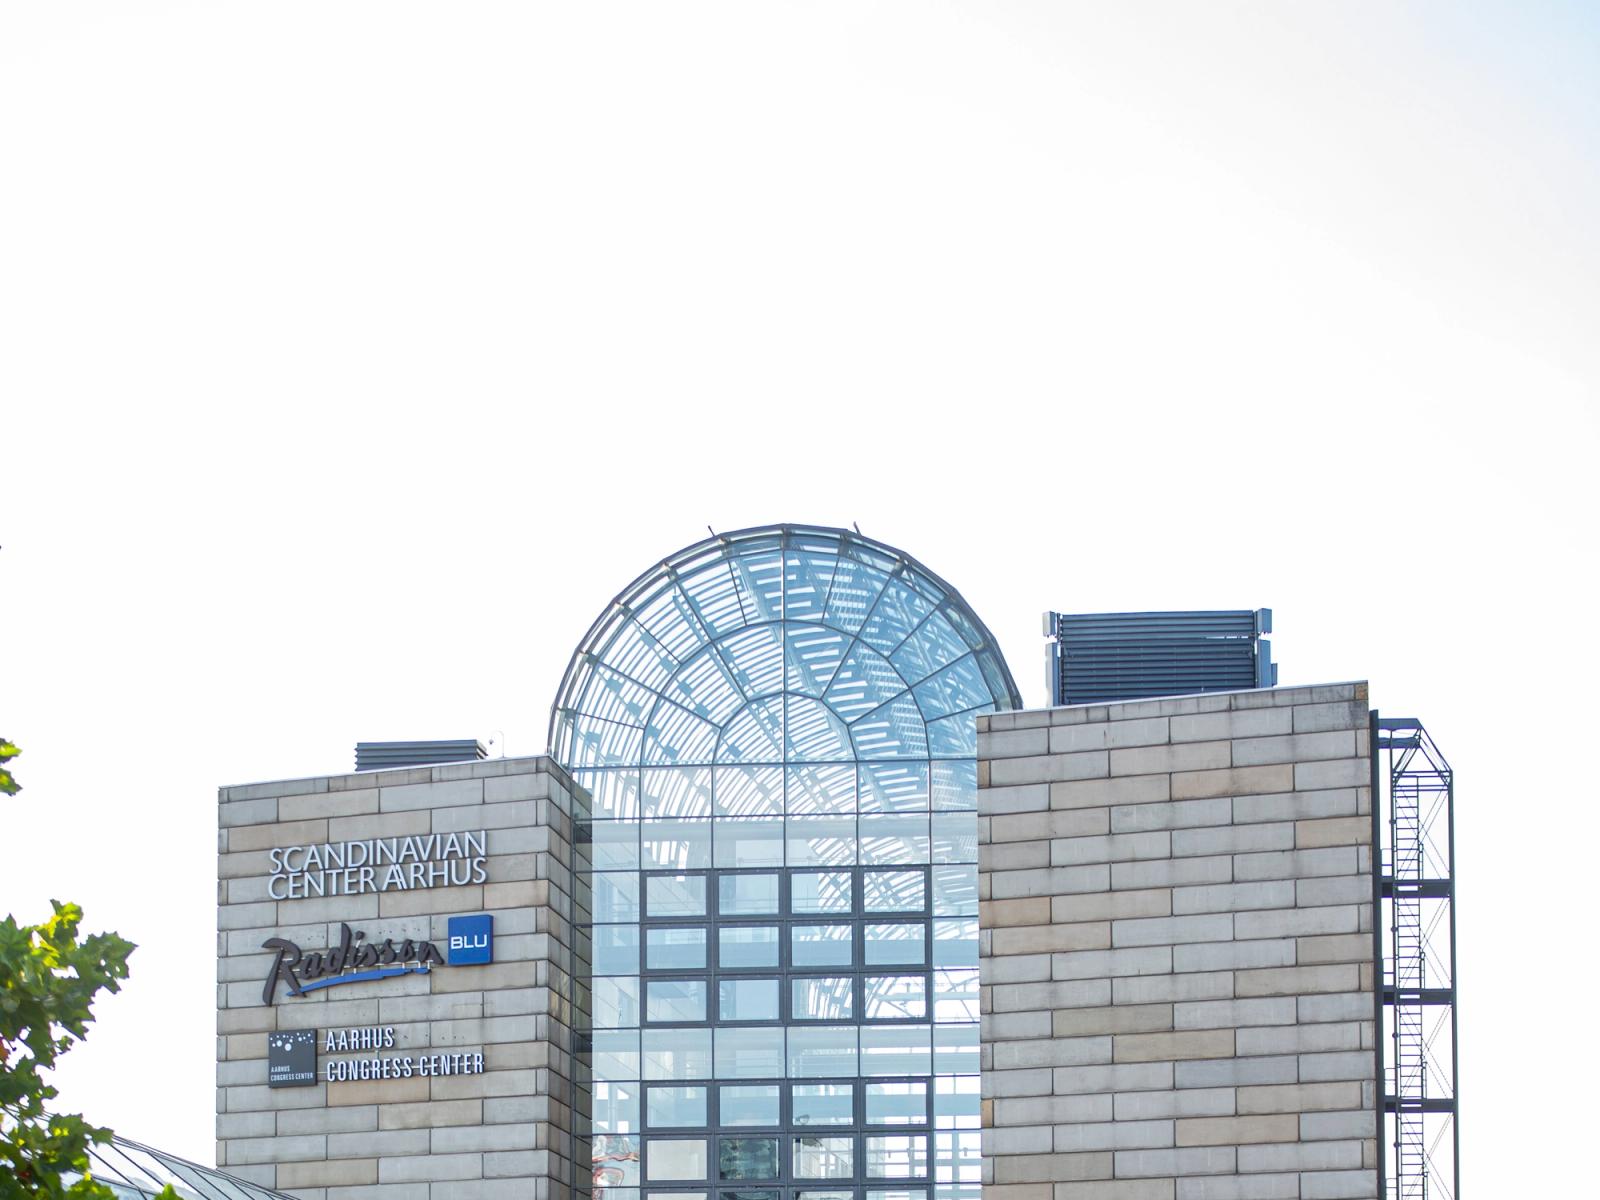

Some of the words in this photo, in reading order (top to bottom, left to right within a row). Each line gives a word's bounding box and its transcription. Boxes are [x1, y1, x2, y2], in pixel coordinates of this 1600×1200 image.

[269, 830, 487, 875] SCANDINAVIAN
[268, 865, 377, 900] CENTER
[261, 922, 445, 1008] Radisson
[451, 934, 488, 950] BLU
[326, 1027, 395, 1052] AARHUS
[326, 1056, 413, 1082] CONGRESS
[419, 1053, 484, 1077] CENTER
